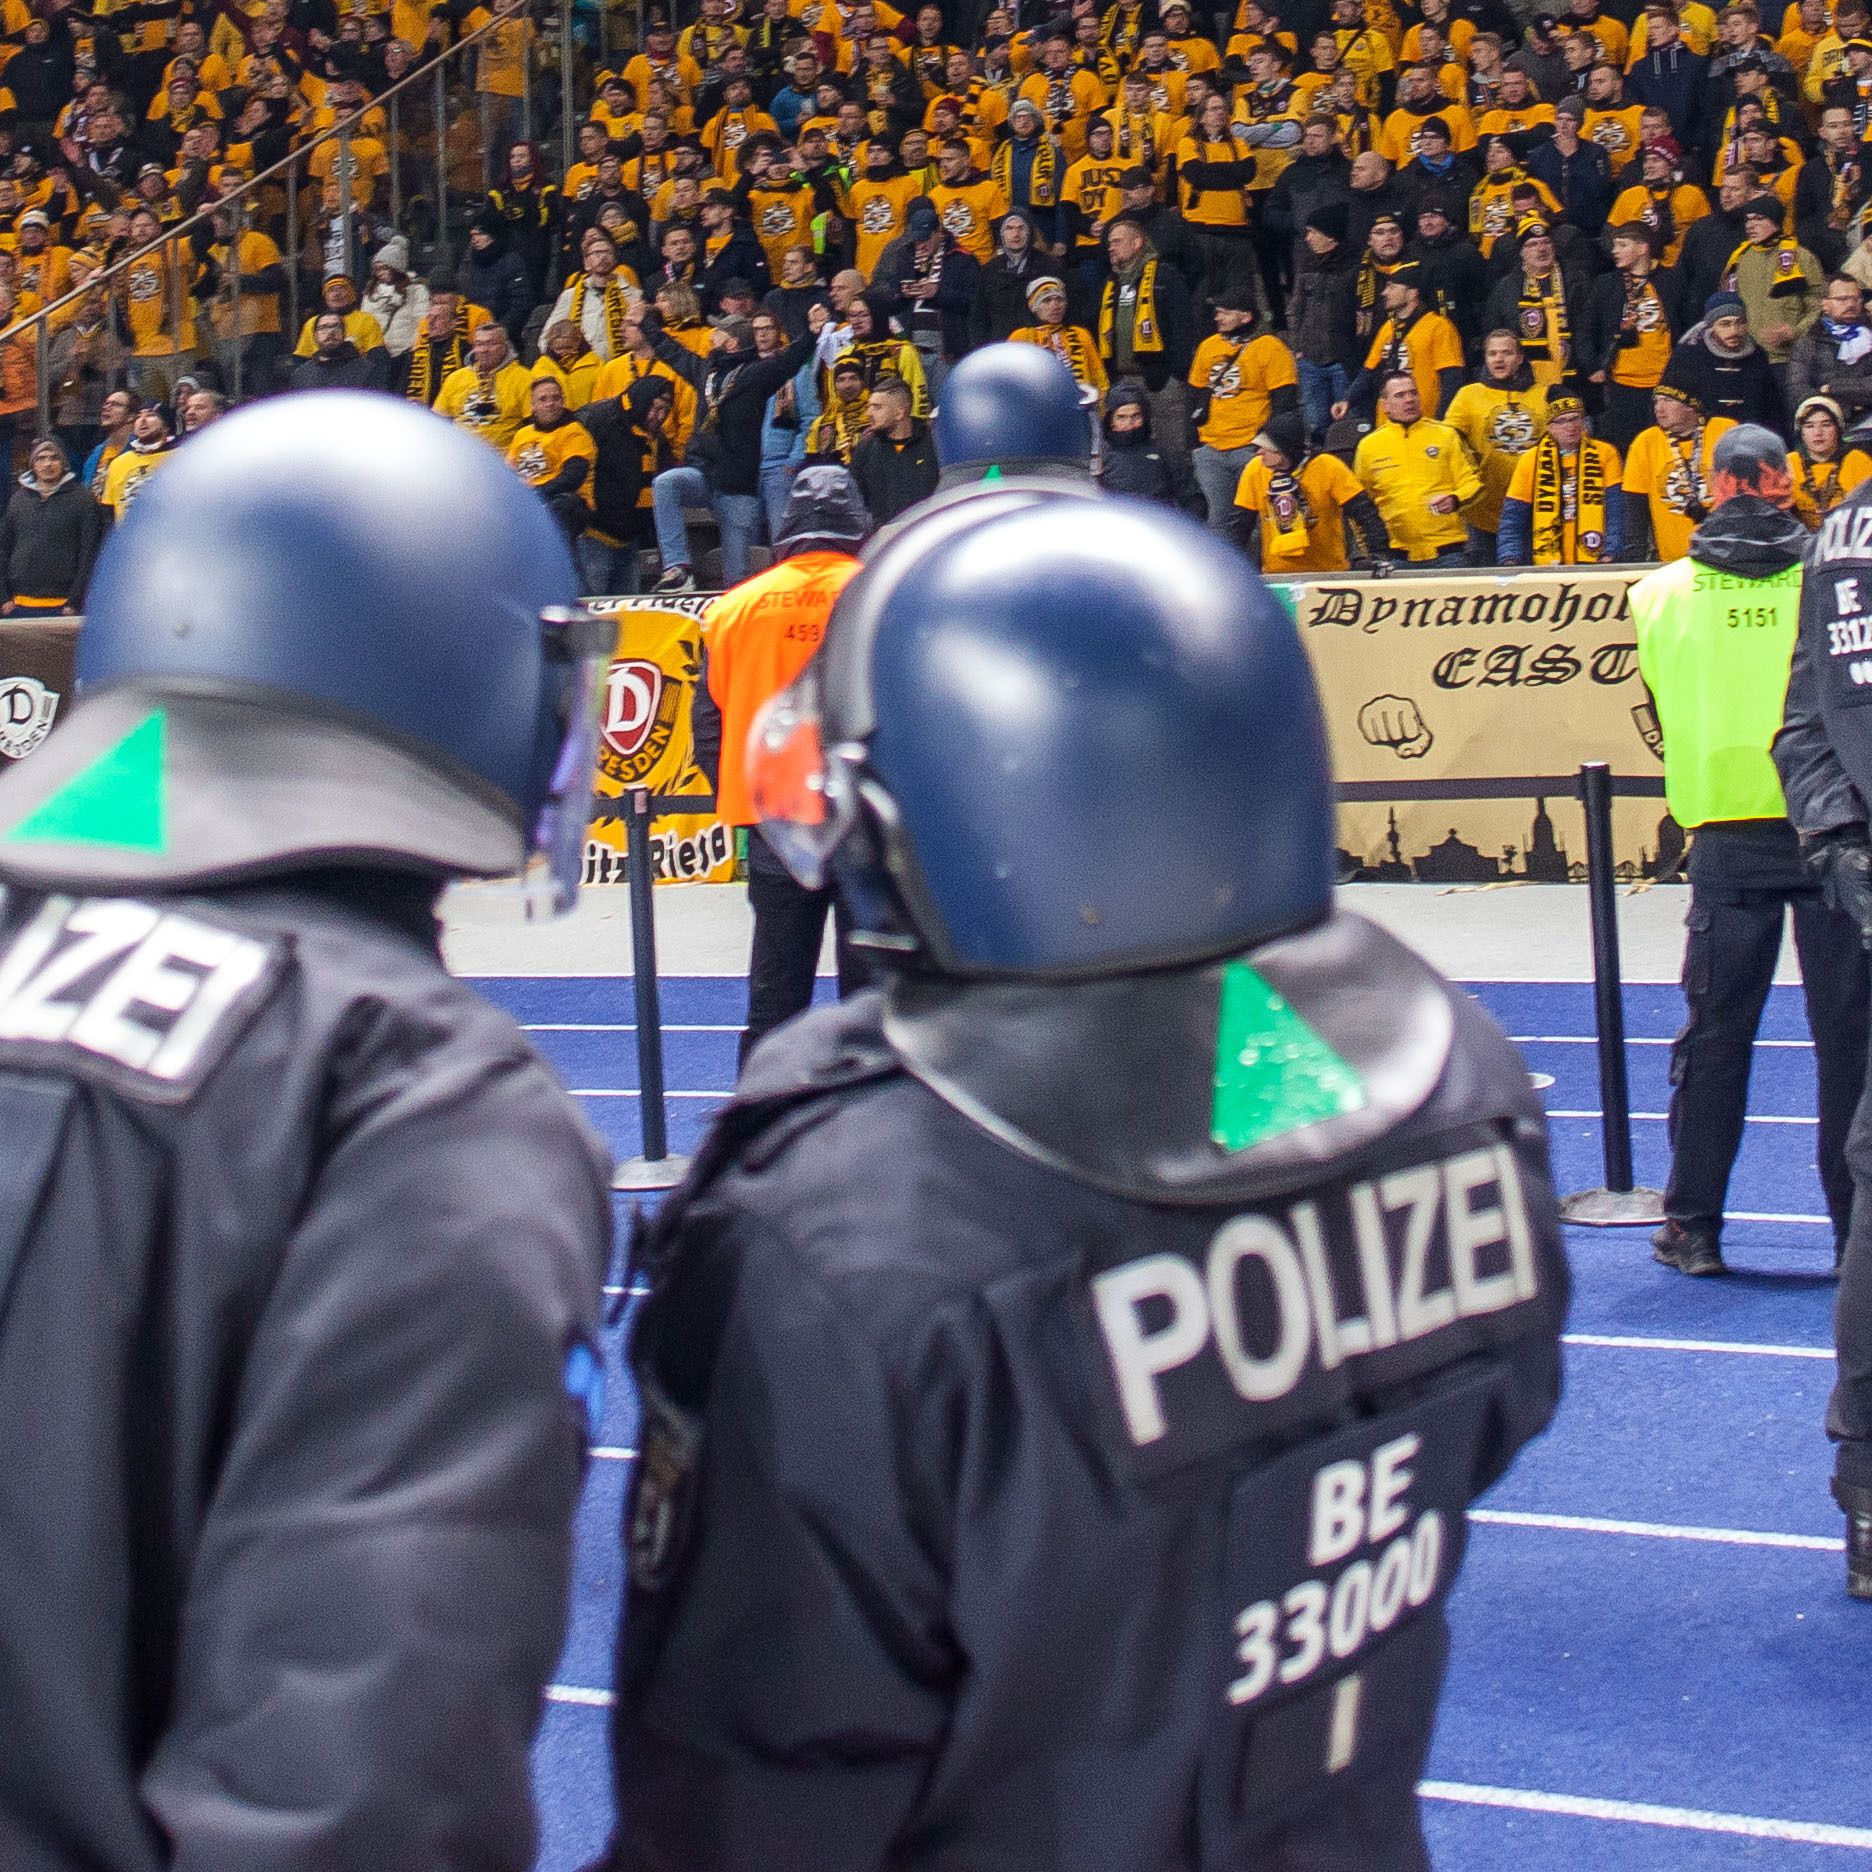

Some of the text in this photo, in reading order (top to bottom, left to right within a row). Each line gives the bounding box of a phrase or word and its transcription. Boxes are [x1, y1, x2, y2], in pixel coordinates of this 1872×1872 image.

[757, 590, 841, 610] STEWA
[1728, 607, 1778, 628] 5151
[1432, 642, 1639, 689] EAST
[1091, 1142, 1537, 1447] POLIZEI
[1309, 1432, 1422, 1568] BE
[1227, 1510, 1442, 1707] 33000
